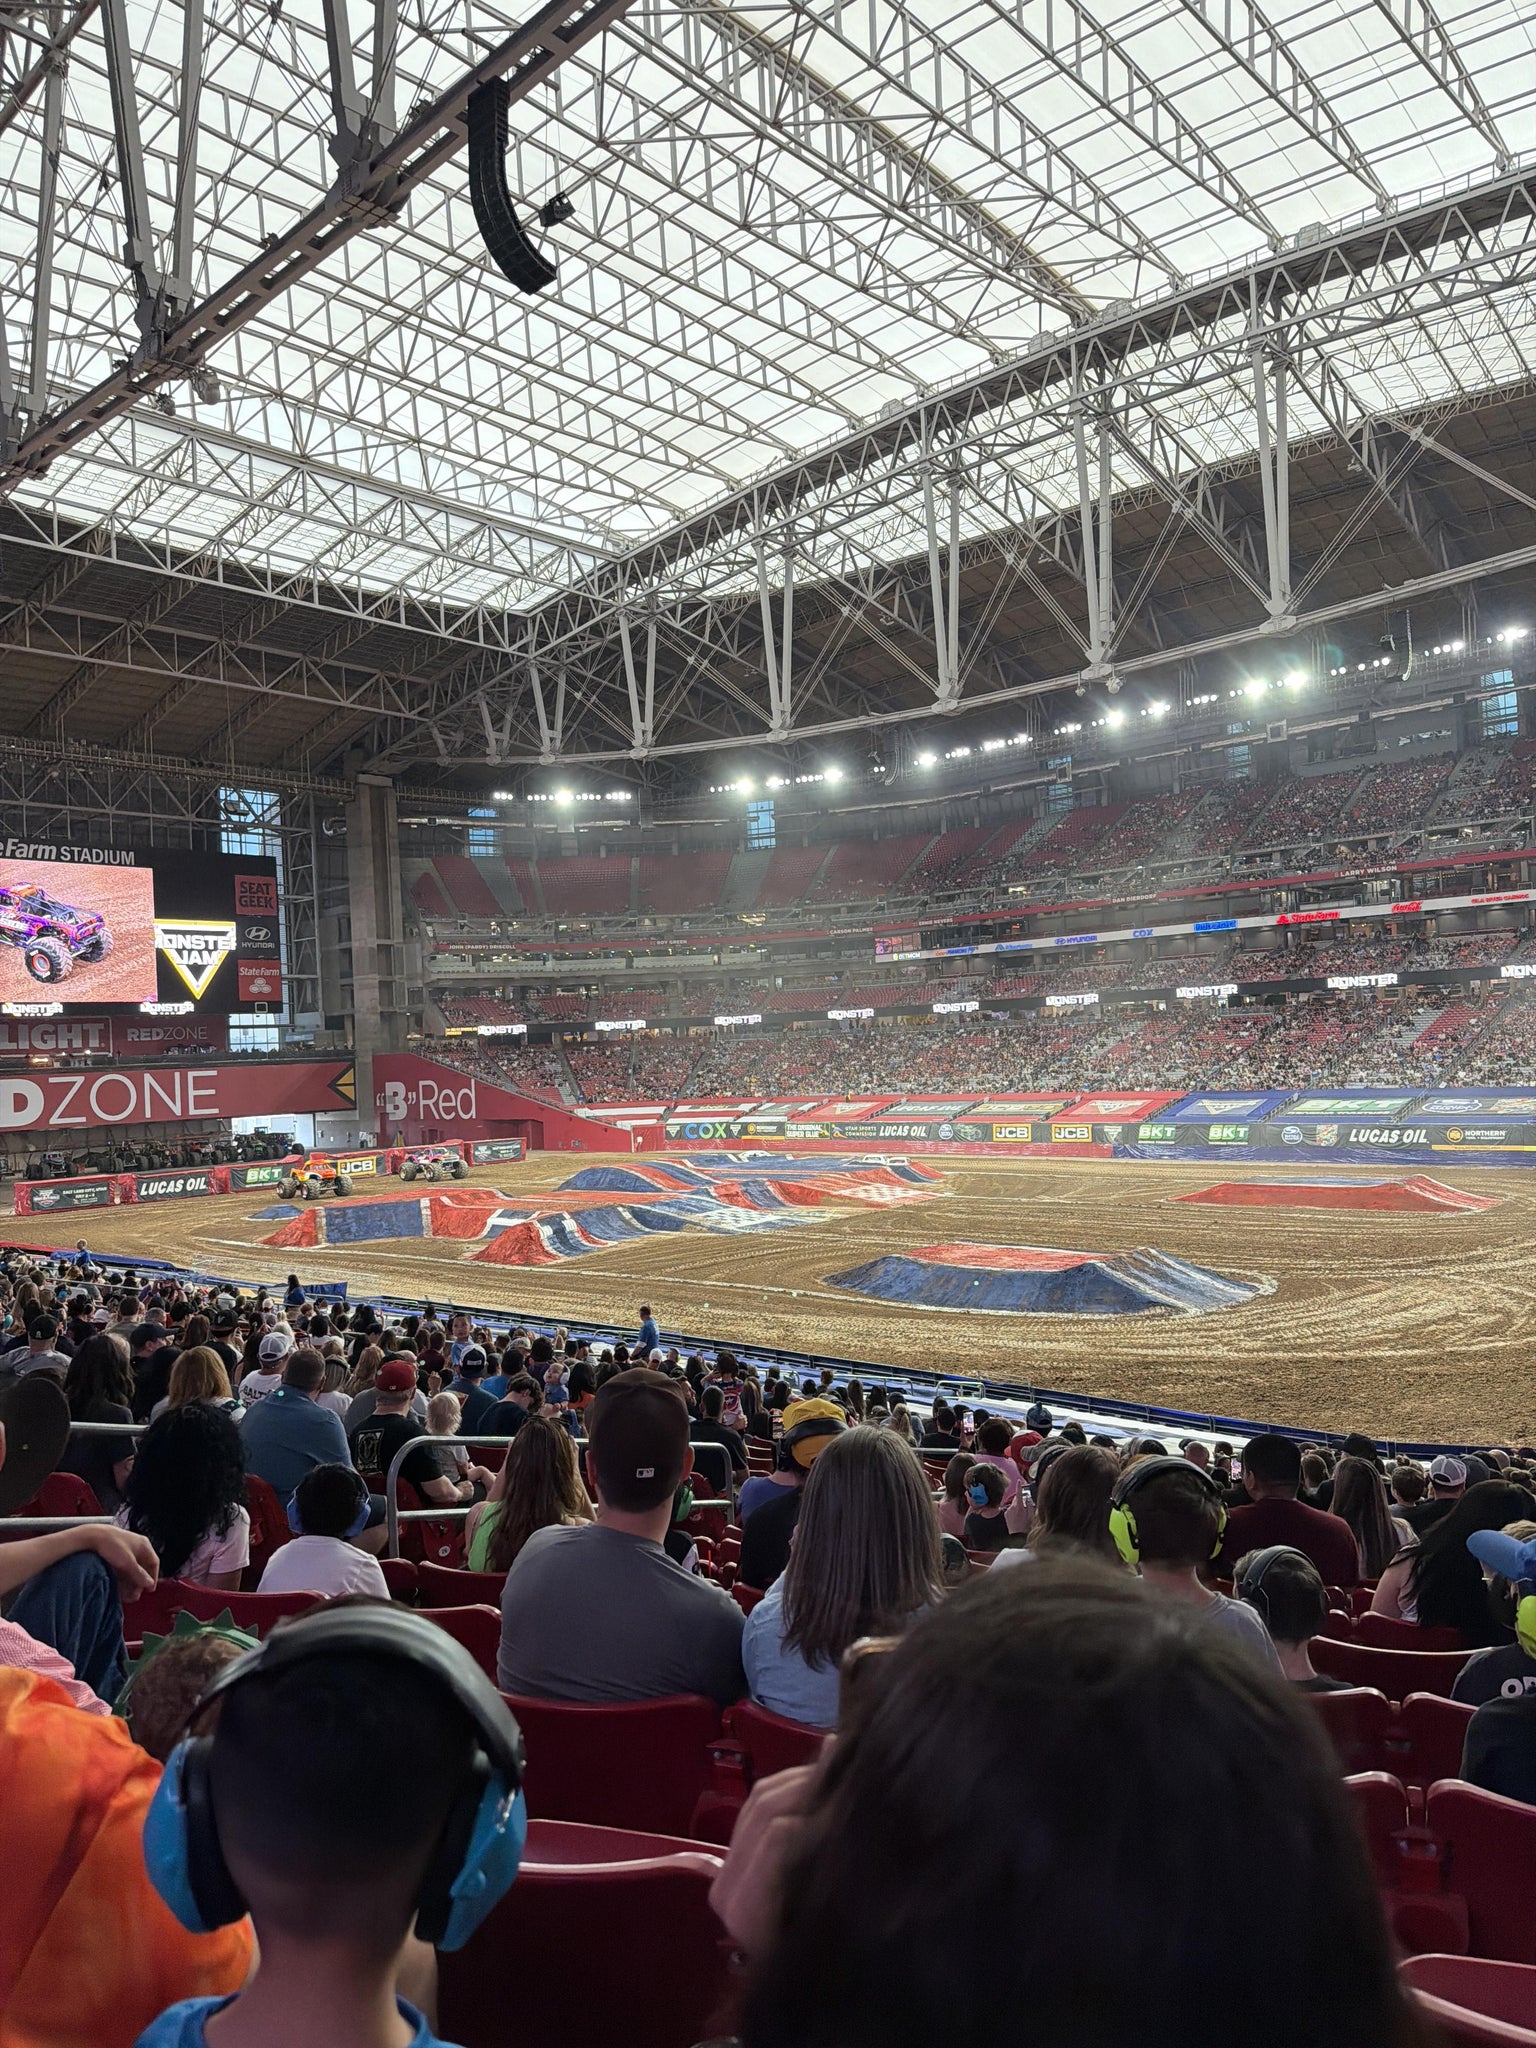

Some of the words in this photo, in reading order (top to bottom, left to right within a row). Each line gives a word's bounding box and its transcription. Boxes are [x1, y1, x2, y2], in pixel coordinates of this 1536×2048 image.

[60, 846, 135, 866] STADIUM
[1340, 868, 1366, 878] LARRY
[1367, 865, 1397, 875] WILSON
[240, 881, 271, 895] SEAT
[239, 895, 274, 909] GEEK
[1133, 928, 1153, 937] COX
[241, 941, 275, 949] HYUNDAI
[174, 951, 218, 966] JAM
[1327, 973, 1398, 989] MONSTER
[1176, 984, 1238, 998] MONSTER
[933, 1001, 979, 1013] MONSTER
[1046, 993, 1099, 1007] MONSTER
[2, 1003, 64, 1014] MONSTER
[140, 1003, 194, 1014] MONSTER
[828, 1008, 874, 1020] MONSTER
[595, 1019, 647, 1030] MONSTER
[714, 1014, 762, 1025] MONSTER
[0, 1023, 105, 1050] LIGHT
[127, 1026, 208, 1041] REDZONE
[477, 1024, 527, 1036] MONSTER
[419, 1078, 477, 1120] Red
[685, 1123, 727, 1139] COX
[879, 1126, 909, 1137] LUCAS
[911, 1126, 927, 1137] OIL
[996, 1127, 1028, 1138] JCB
[1055, 1127, 1088, 1138] JCB
[1139, 1125, 1175, 1139] BKT
[1209, 1125, 1248, 1140] BKT
[1349, 1128, 1400, 1144] LUCAS
[1403, 1129, 1428, 1144] OIL
[341, 1161, 373, 1174] JCB
[247, 1167, 283, 1183] BKT
[140, 1180, 183, 1196] LUCAS
[186, 1177, 207, 1191] OIL
